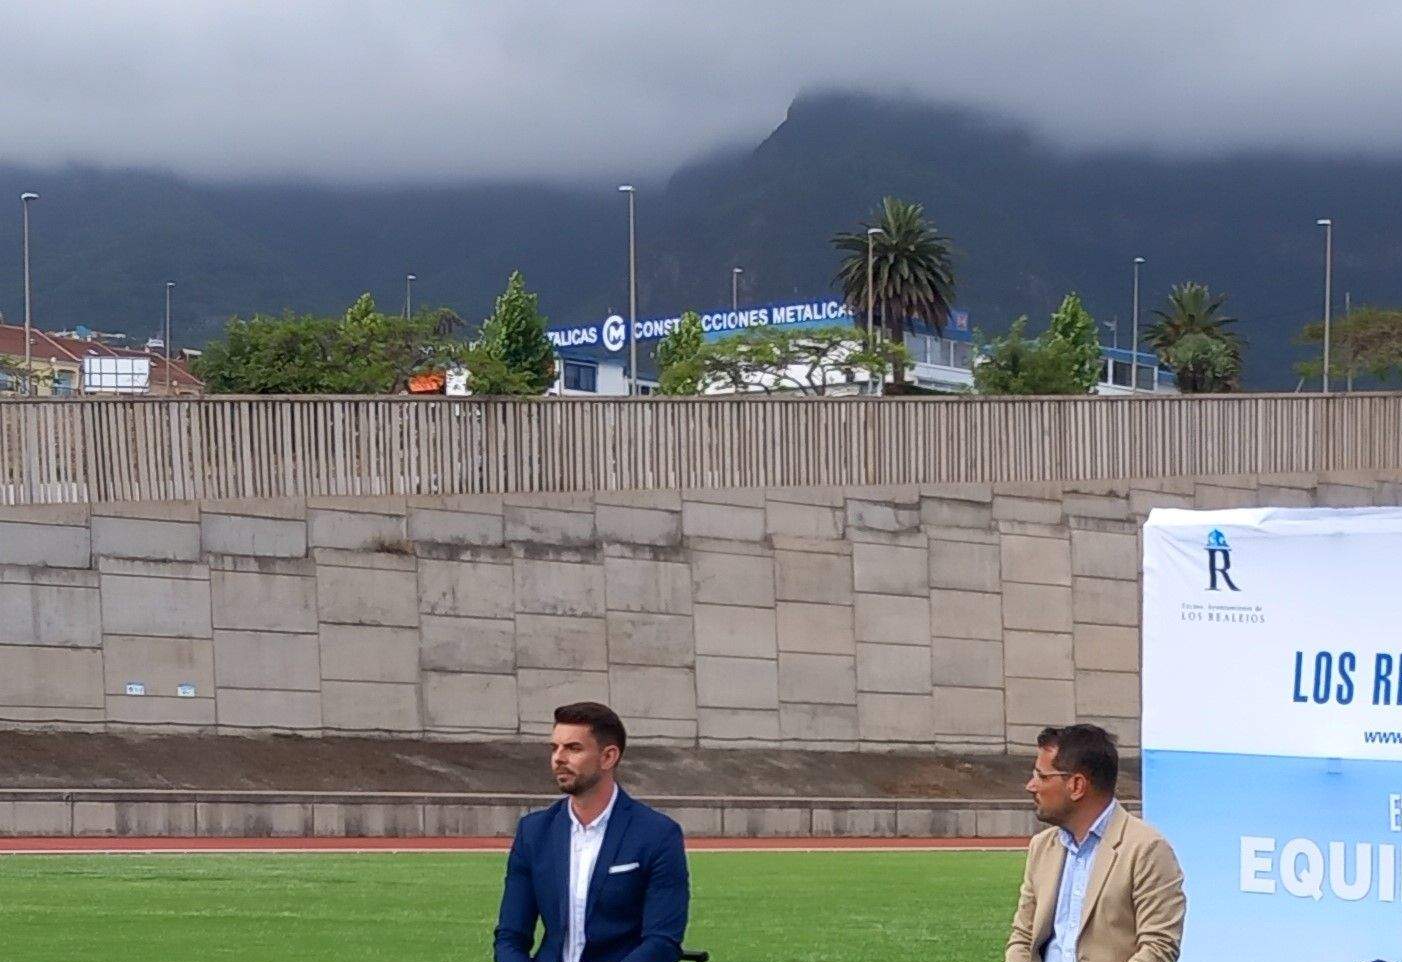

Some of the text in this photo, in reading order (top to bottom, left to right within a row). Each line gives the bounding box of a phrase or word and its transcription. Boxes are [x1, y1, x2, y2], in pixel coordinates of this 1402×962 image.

[545, 327, 598, 346] TALICAS
[634, 308, 769, 339] CONSTCCIONES
[1181, 611, 1203, 622] LOS
[1293, 651, 1356, 705] LOS
